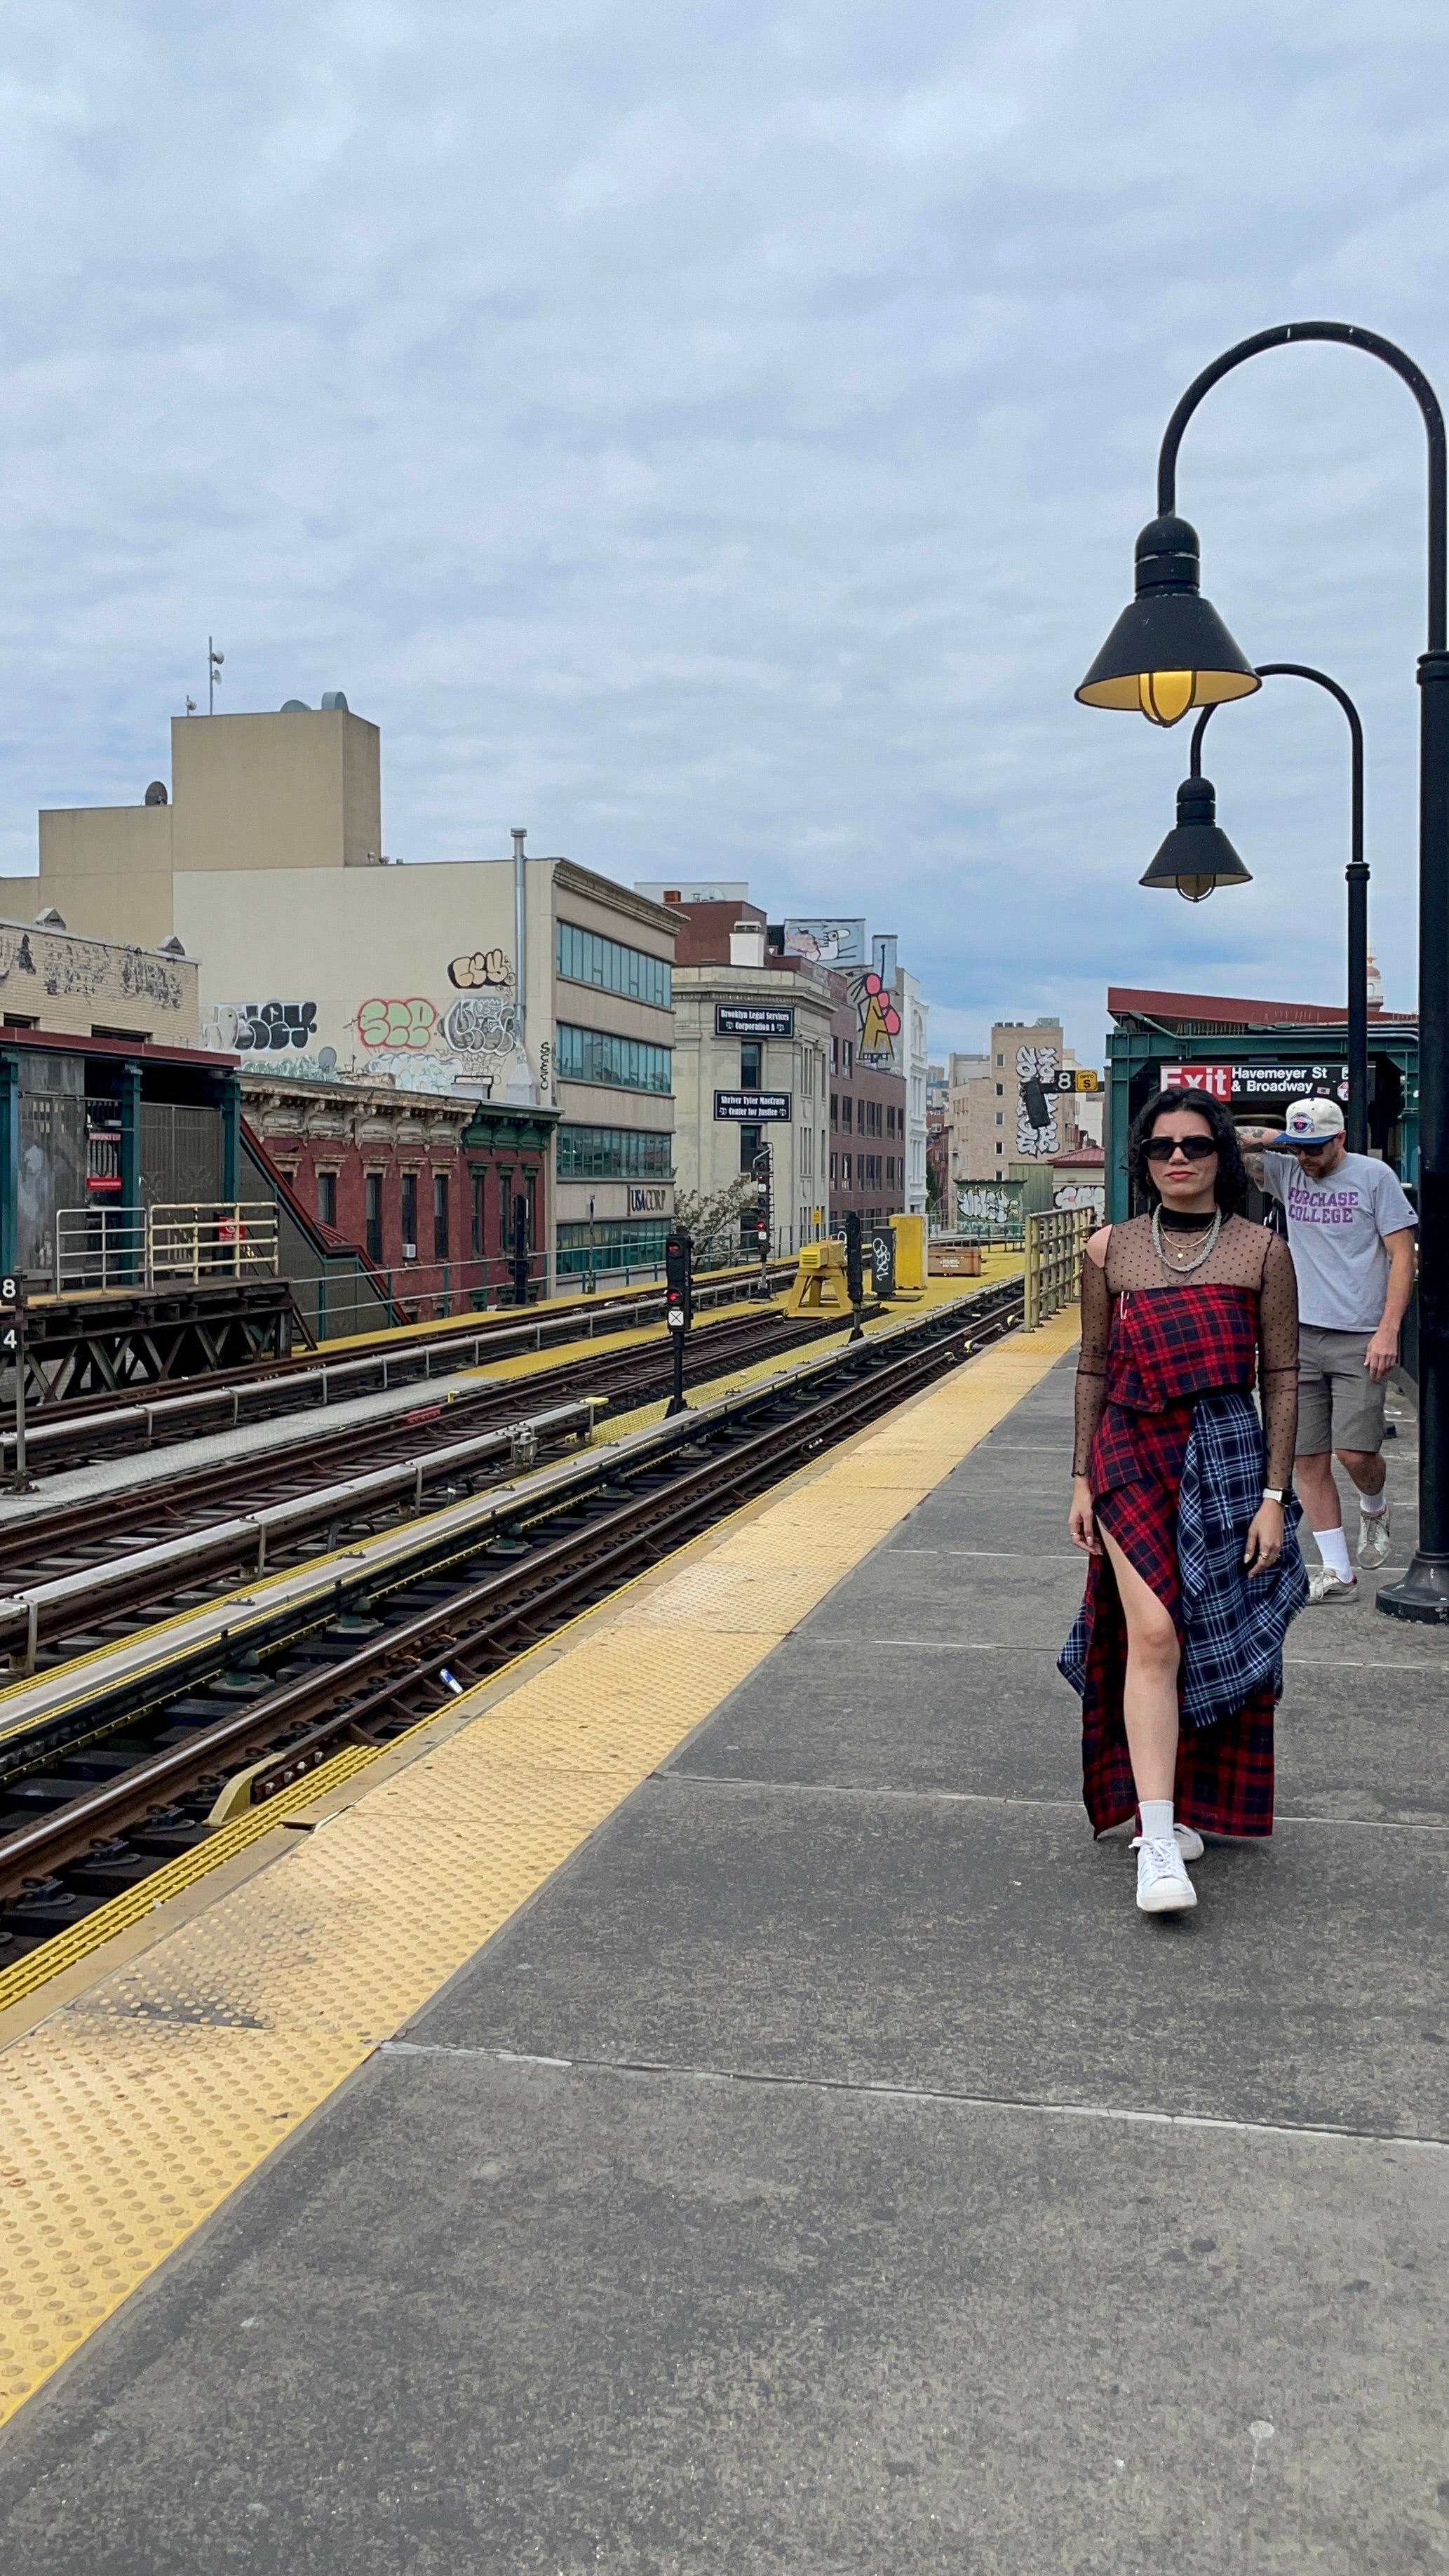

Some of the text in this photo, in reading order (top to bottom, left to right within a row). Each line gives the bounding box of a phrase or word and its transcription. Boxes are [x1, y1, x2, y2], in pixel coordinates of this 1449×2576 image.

[720, 1009, 789, 1021] Brooklyn Legal Services
[735, 1021, 775, 1031] Corporation A
[1058, 1072, 1072, 1089] 8
[1083, 1079, 1091, 1088] S
[1161, 1067, 1328, 1096] Exit Havemeyer St
[1231, 1080, 1313, 1094] & Broadway
[720, 1096, 786, 1106] Shriver Tyler MacCrate
[729, 1107, 779, 1117] Center for Justice
[1288, 1186, 1359, 1207] PURCHASE
[1288, 1204, 1354, 1224] COLLEGE
[2, 1278, 17, 1299] 8
[3, 1328, 18, 1349] 4
